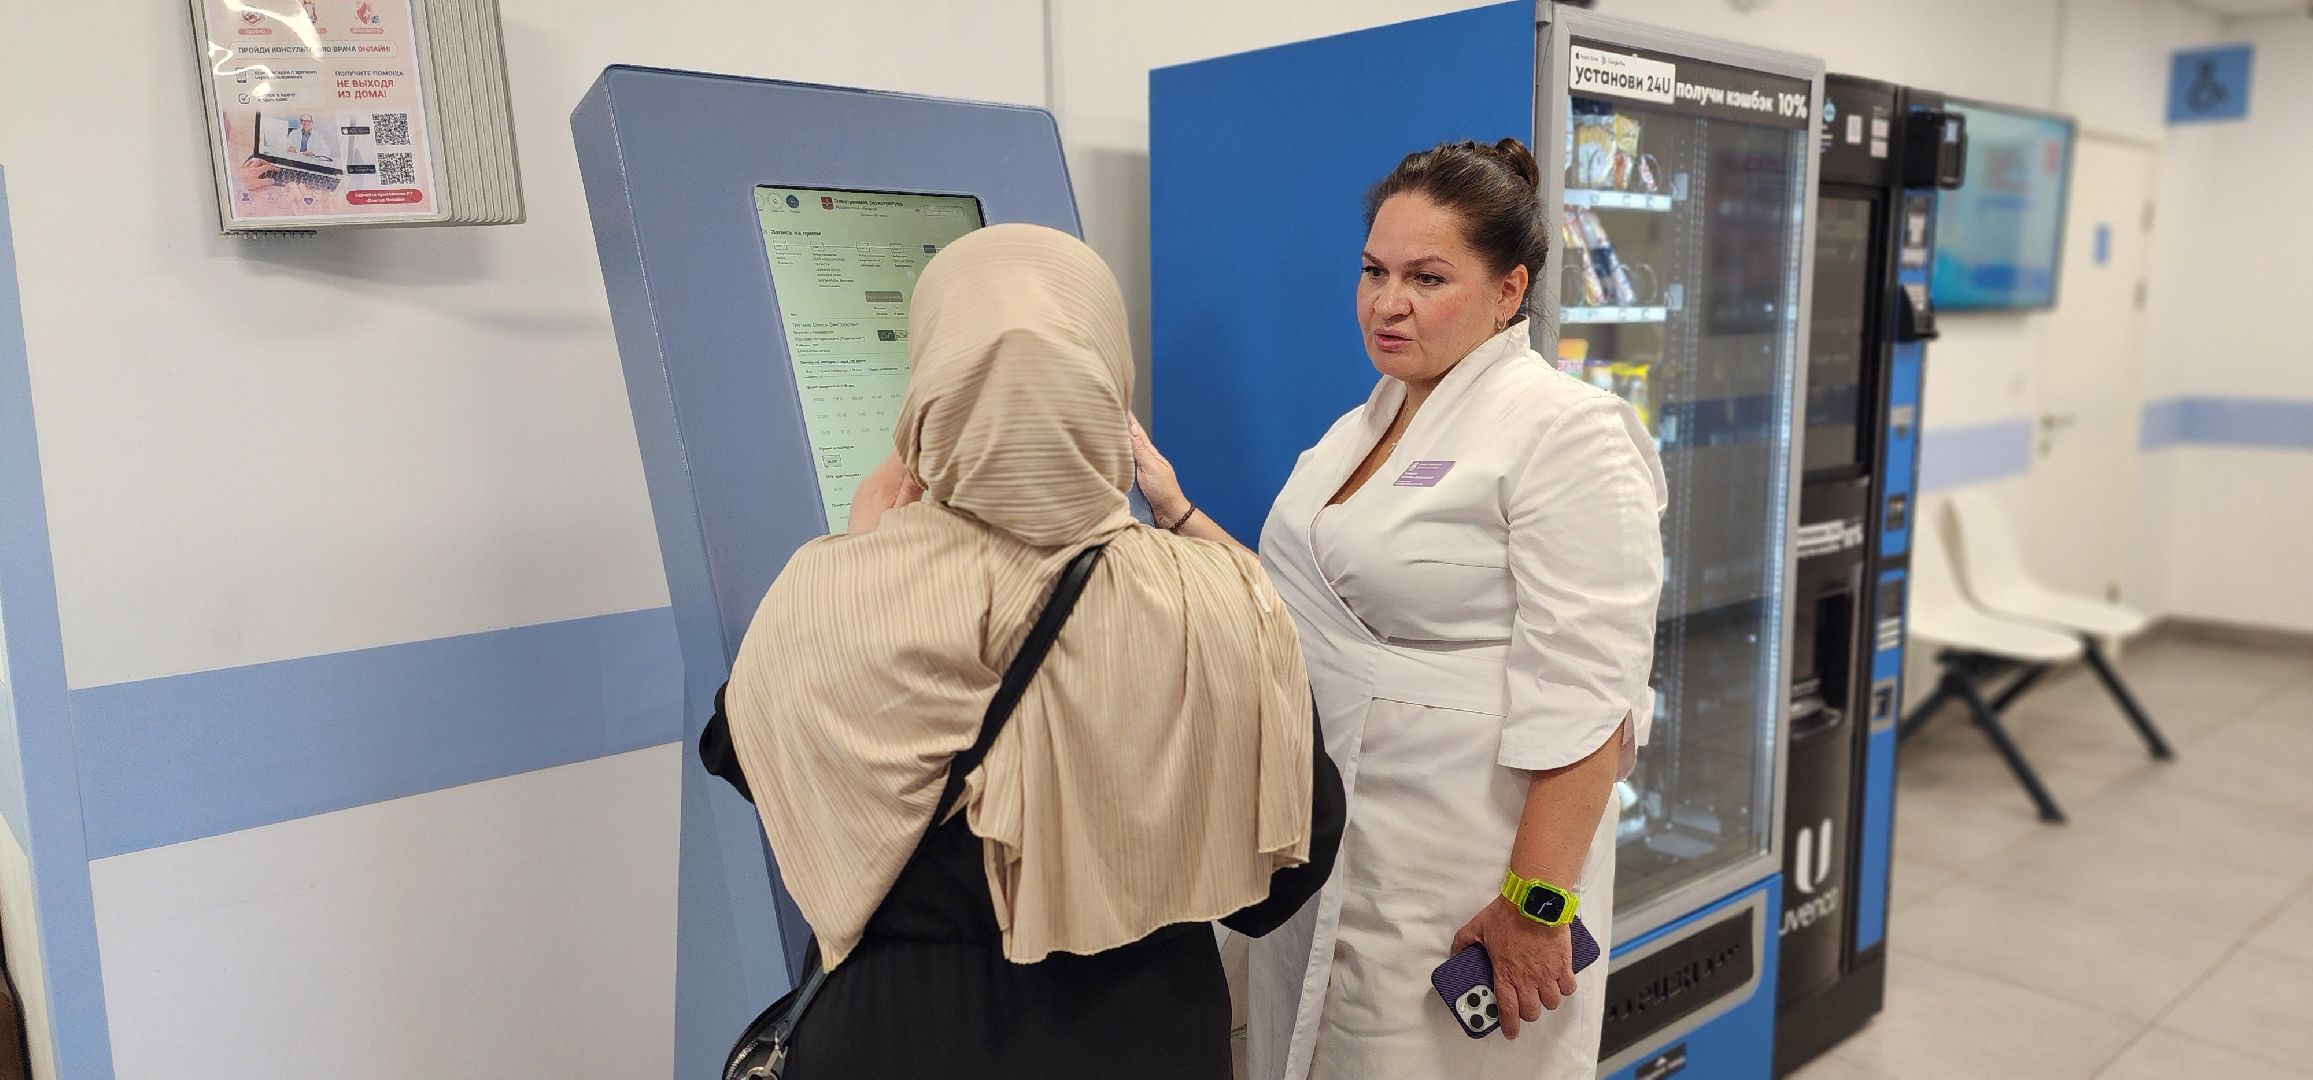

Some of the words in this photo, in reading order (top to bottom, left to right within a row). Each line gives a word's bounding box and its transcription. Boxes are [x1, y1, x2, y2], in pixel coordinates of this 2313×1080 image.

[238, 46, 270, 54] ПРОЙДИ
[271, 45, 332, 54] КОНСУЛЬТИЮ
[336, 80, 350, 88] НЕ
[352, 79, 394, 89] ВЫХОДЯ
[1575, 64, 1643, 90] установи
[1647, 75, 1671, 95] 24U
[337, 90, 351, 98] ИЗ
[354, 90, 387, 100] ДОМА!
[1676, 82, 1724, 106] получи
[1726, 90, 1774, 112] кэшбэк
[1778, 93, 1808, 119] 10%
